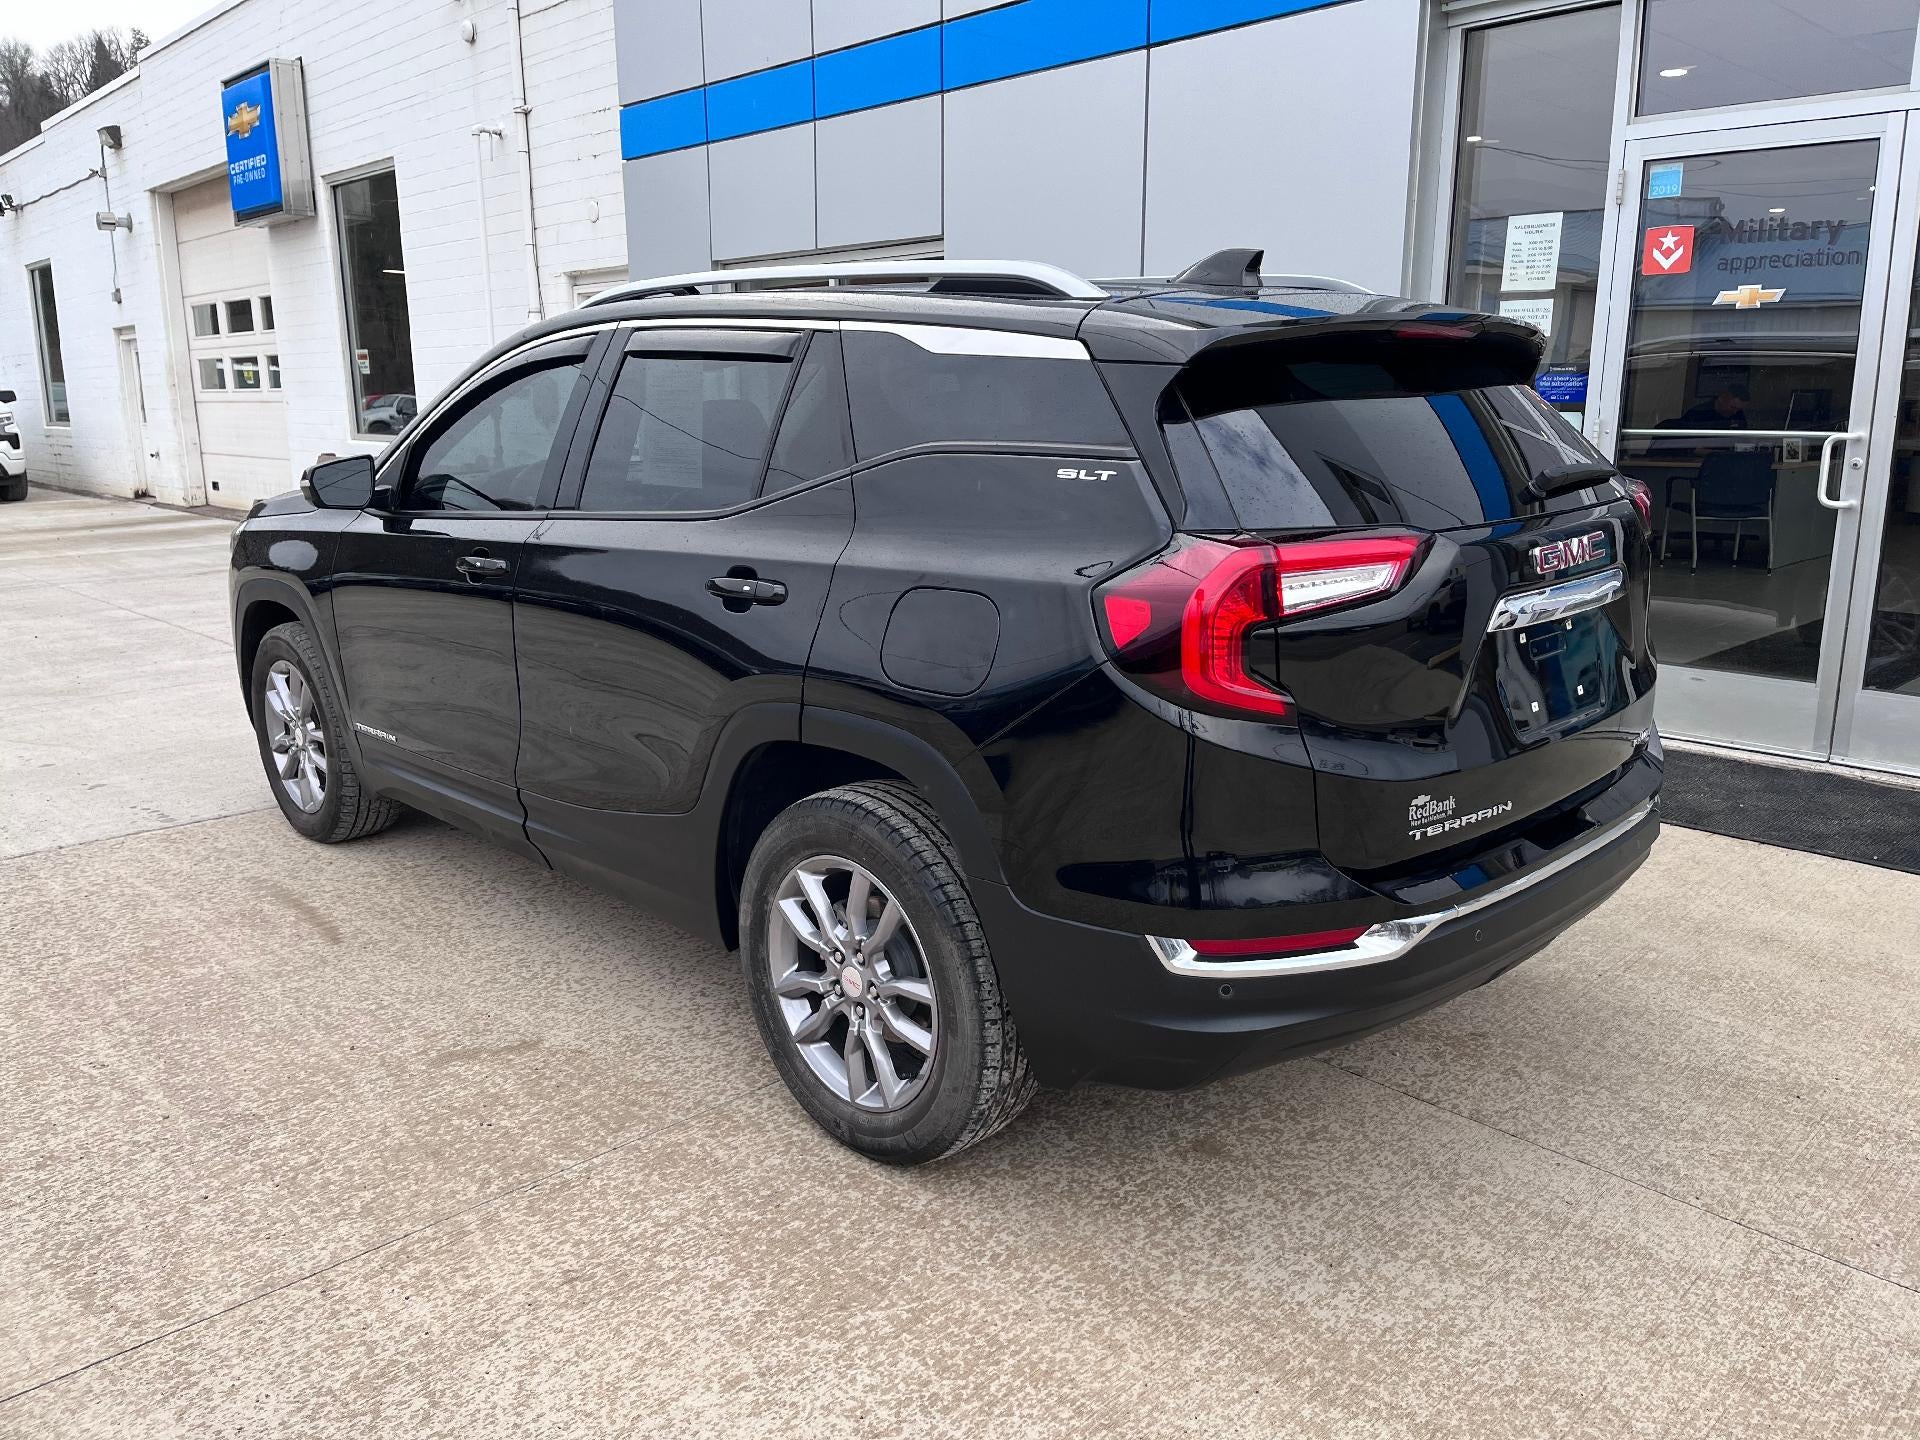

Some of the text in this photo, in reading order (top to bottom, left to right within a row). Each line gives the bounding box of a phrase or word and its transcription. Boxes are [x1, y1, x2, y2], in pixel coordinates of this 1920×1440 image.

[230, 154, 267, 175] CERTIFIED
[233, 167, 266, 186] PRE-OWNED
[1652, 183, 1678, 195] 2019
[1717, 216, 1844, 246] Military
[1717, 247, 1863, 274] appreciation
[1056, 468, 1118, 481] SLT
[1529, 530, 1606, 575] GMC
[355, 722, 397, 743] TERRAIN
[1408, 795, 1457, 821] RedBank
[1408, 800, 1513, 841] TERRAIN
